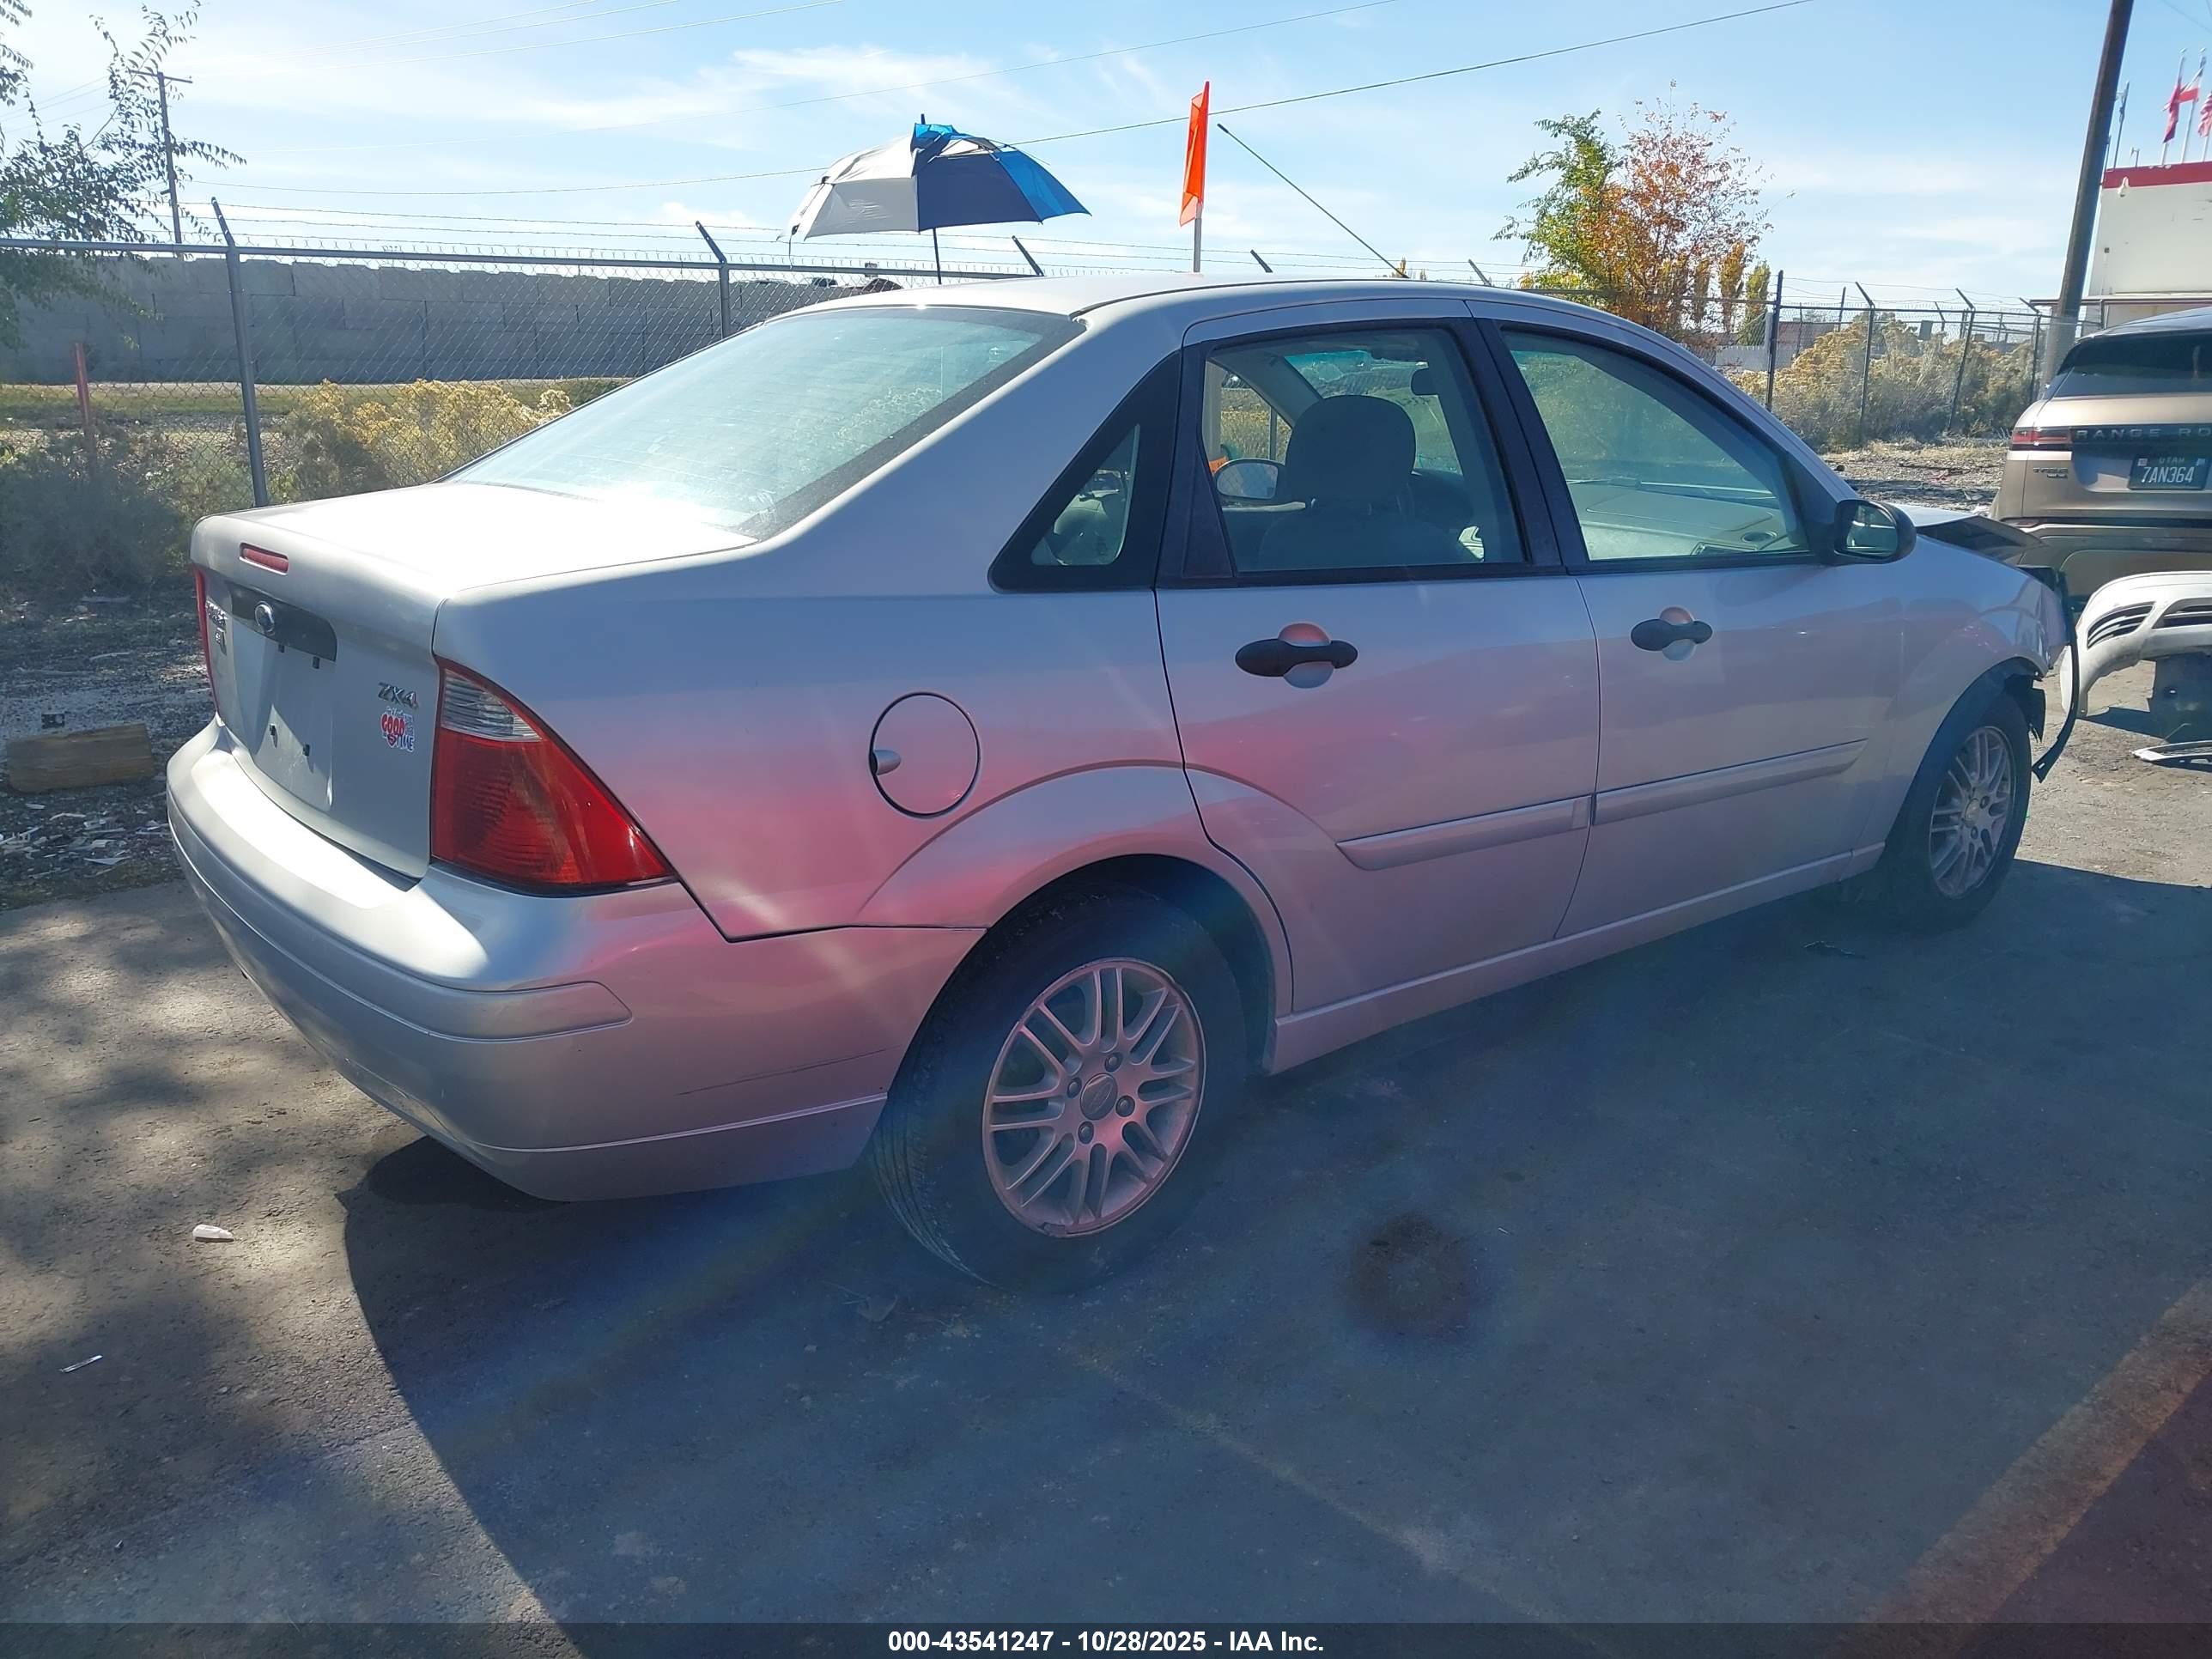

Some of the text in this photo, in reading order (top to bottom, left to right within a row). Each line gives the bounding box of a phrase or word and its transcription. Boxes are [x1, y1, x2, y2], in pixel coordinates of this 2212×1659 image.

[2075, 428, 2161, 440] RANGE
[2141, 466, 2195, 483] 7AN364
[378, 682, 418, 710] ZX4
